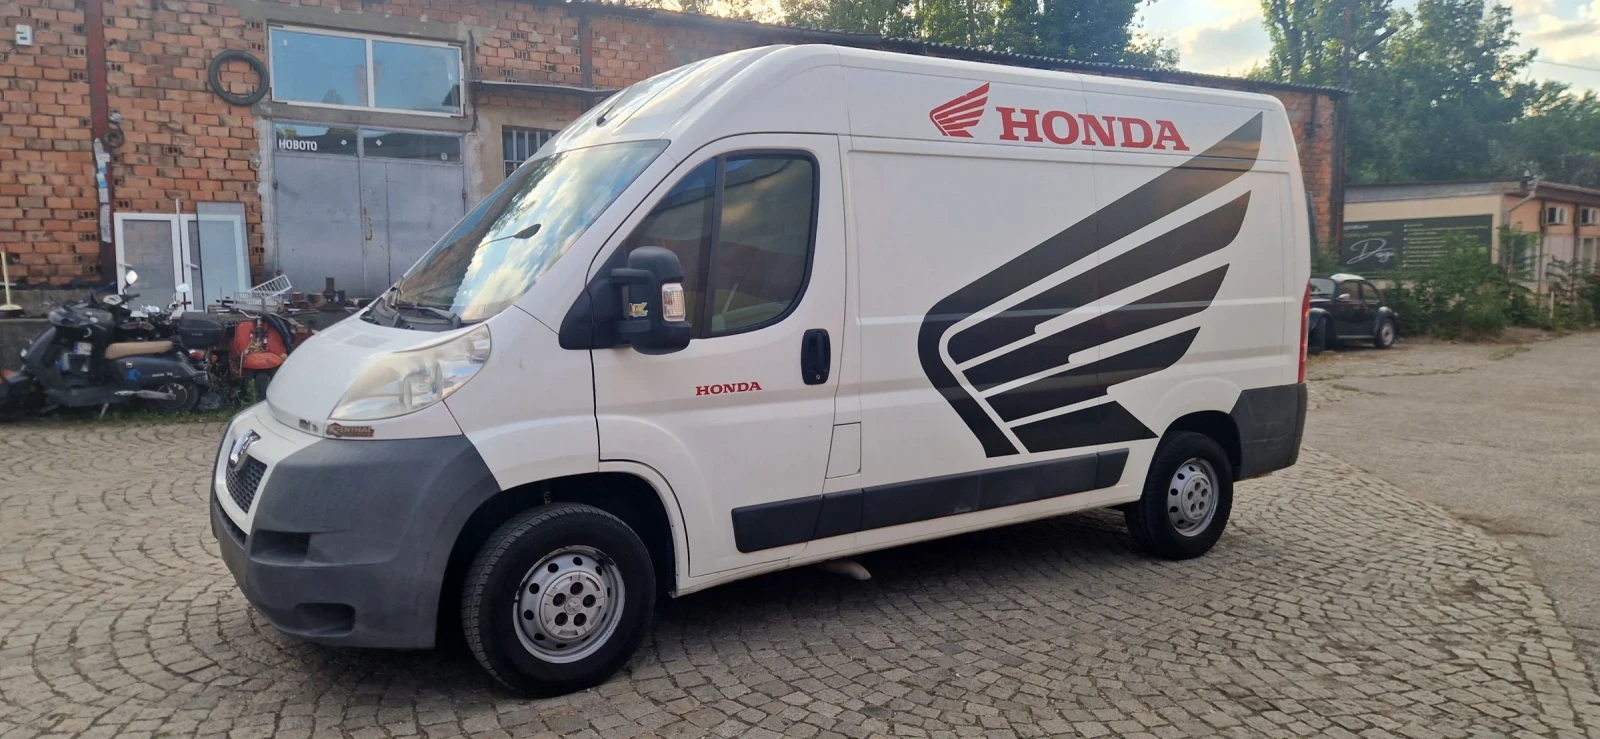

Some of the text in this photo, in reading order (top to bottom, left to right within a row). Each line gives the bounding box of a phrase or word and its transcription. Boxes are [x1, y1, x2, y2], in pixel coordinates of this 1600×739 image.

[996, 107, 1190, 151] HONDA
[279, 139, 317, 151] НОВОТО
[695, 381, 762, 396] HONDA
